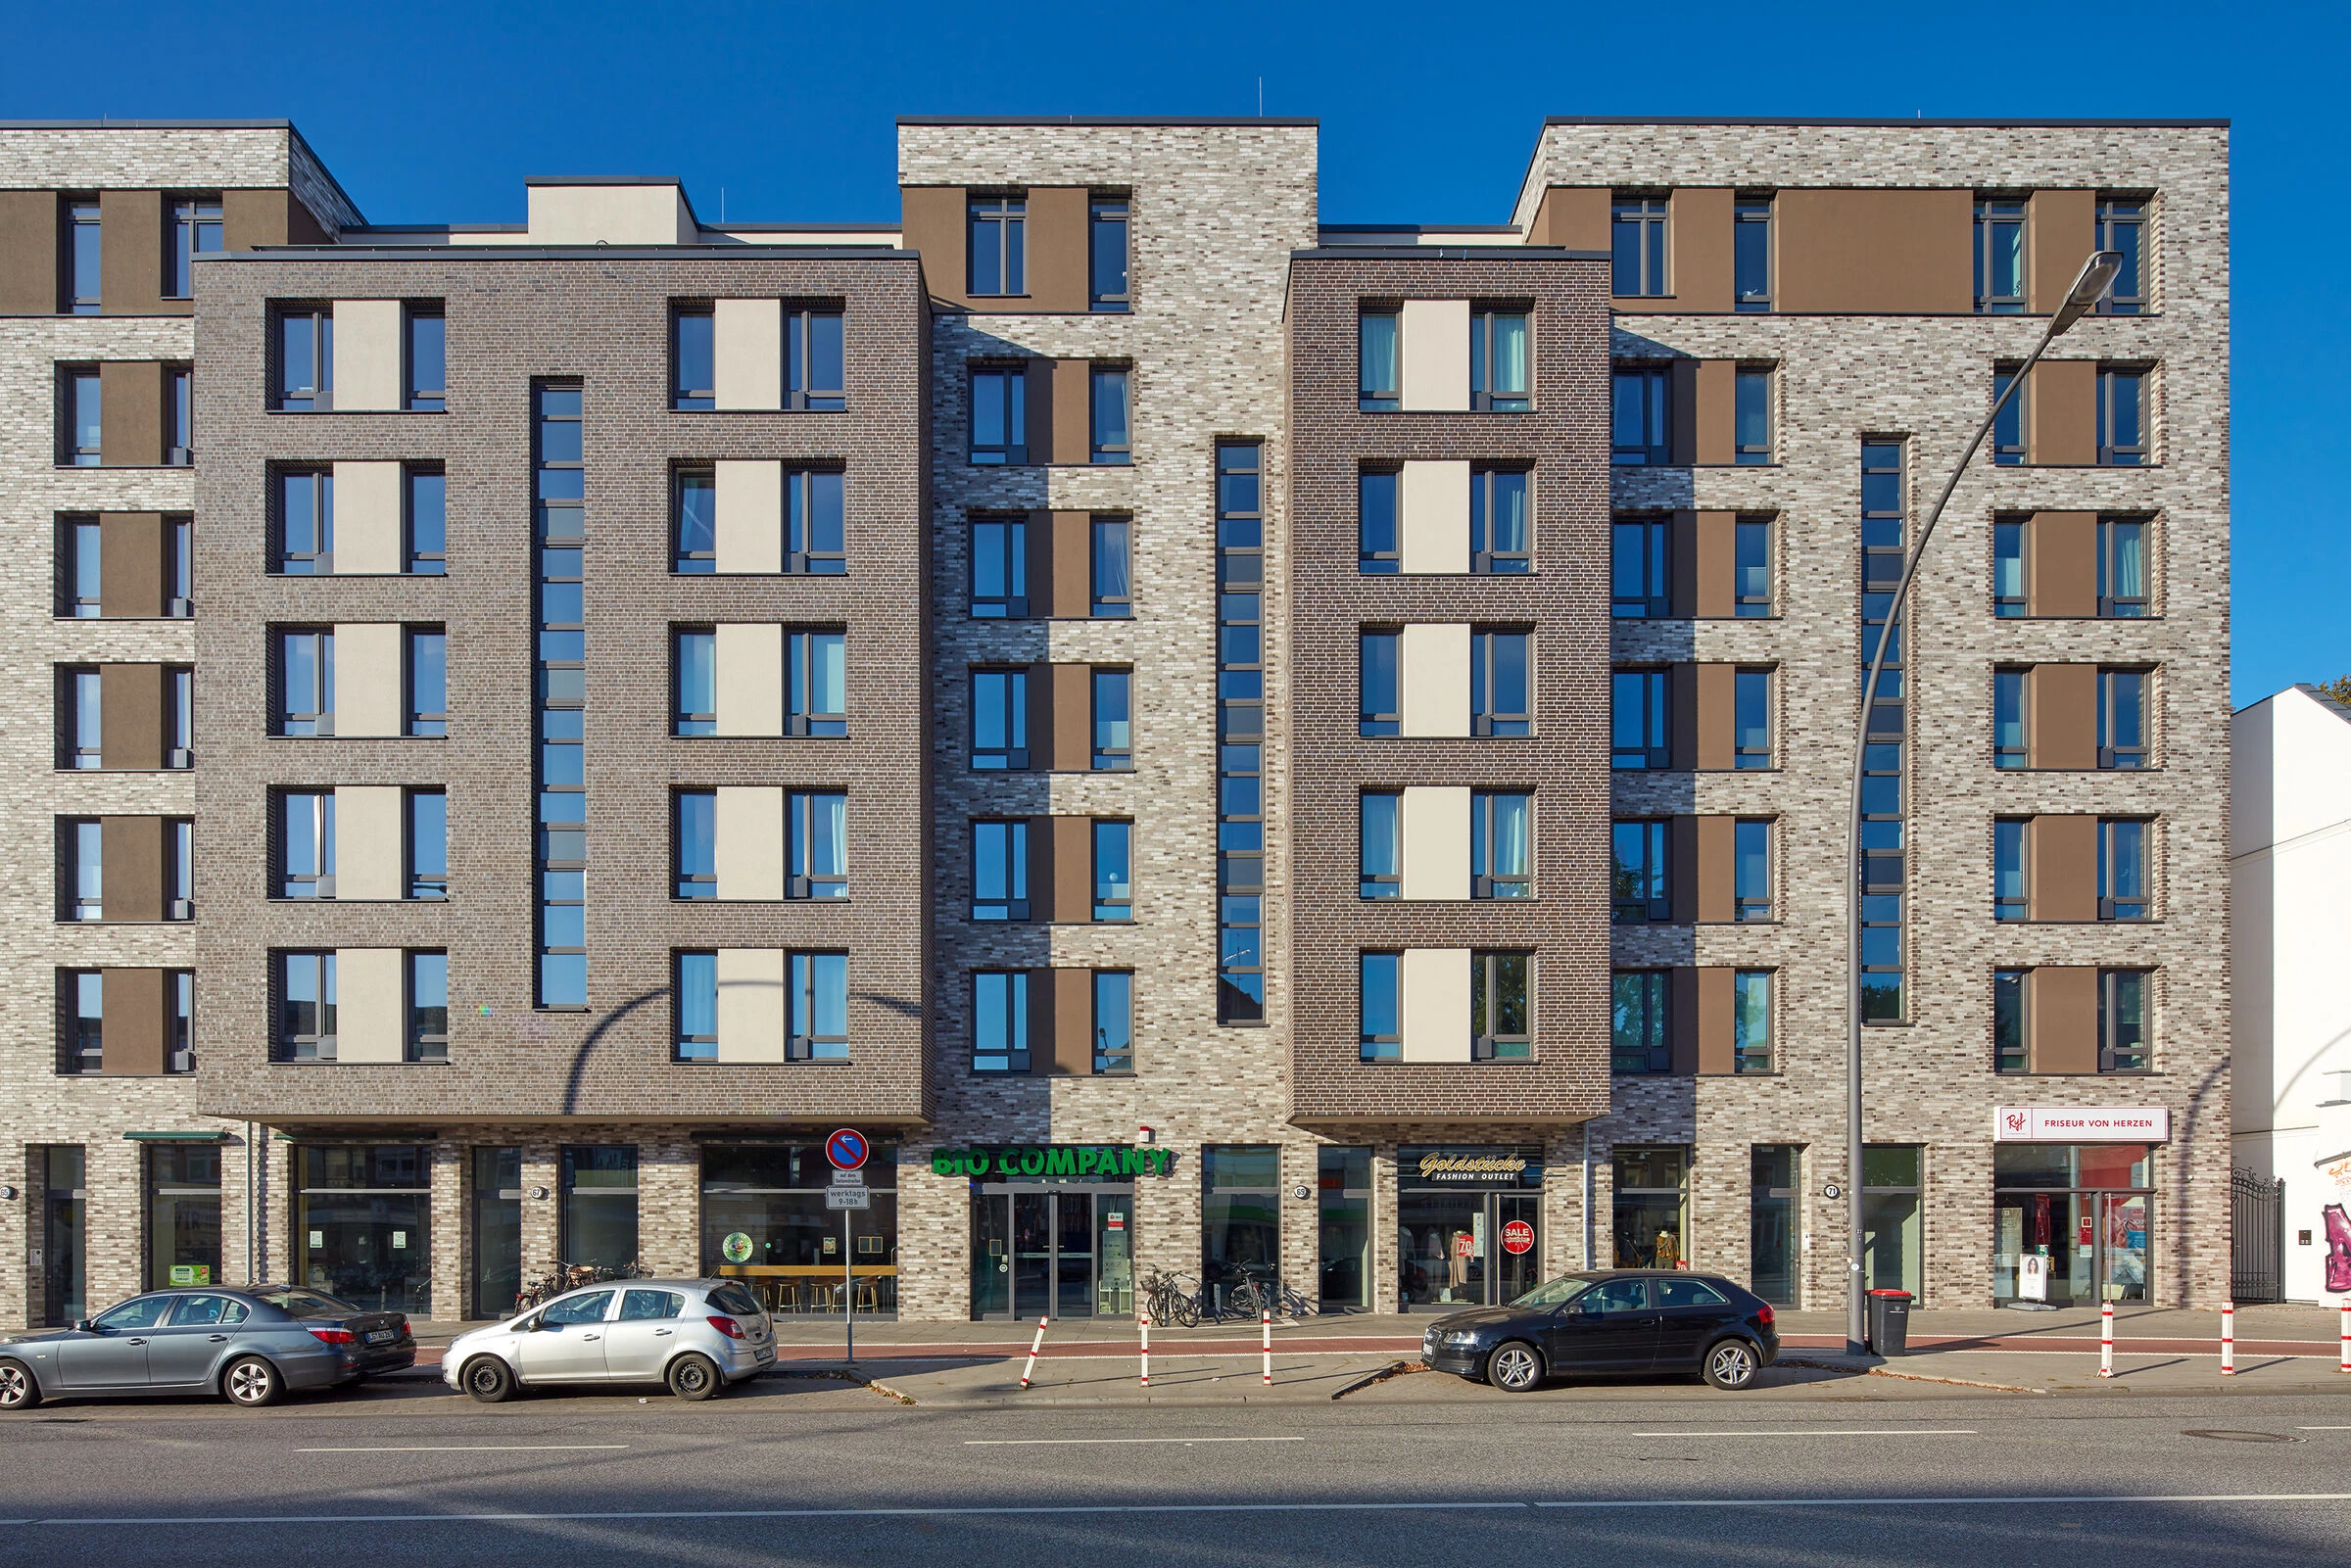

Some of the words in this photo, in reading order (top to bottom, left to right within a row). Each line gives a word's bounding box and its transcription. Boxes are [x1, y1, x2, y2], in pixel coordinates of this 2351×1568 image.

[932, 1148, 989, 1175] BIO
[998, 1147, 1171, 1175] COMPANY
[1419, 1152, 1526, 1177] Goldstücke
[1505, 1228, 1529, 1237] SALE
